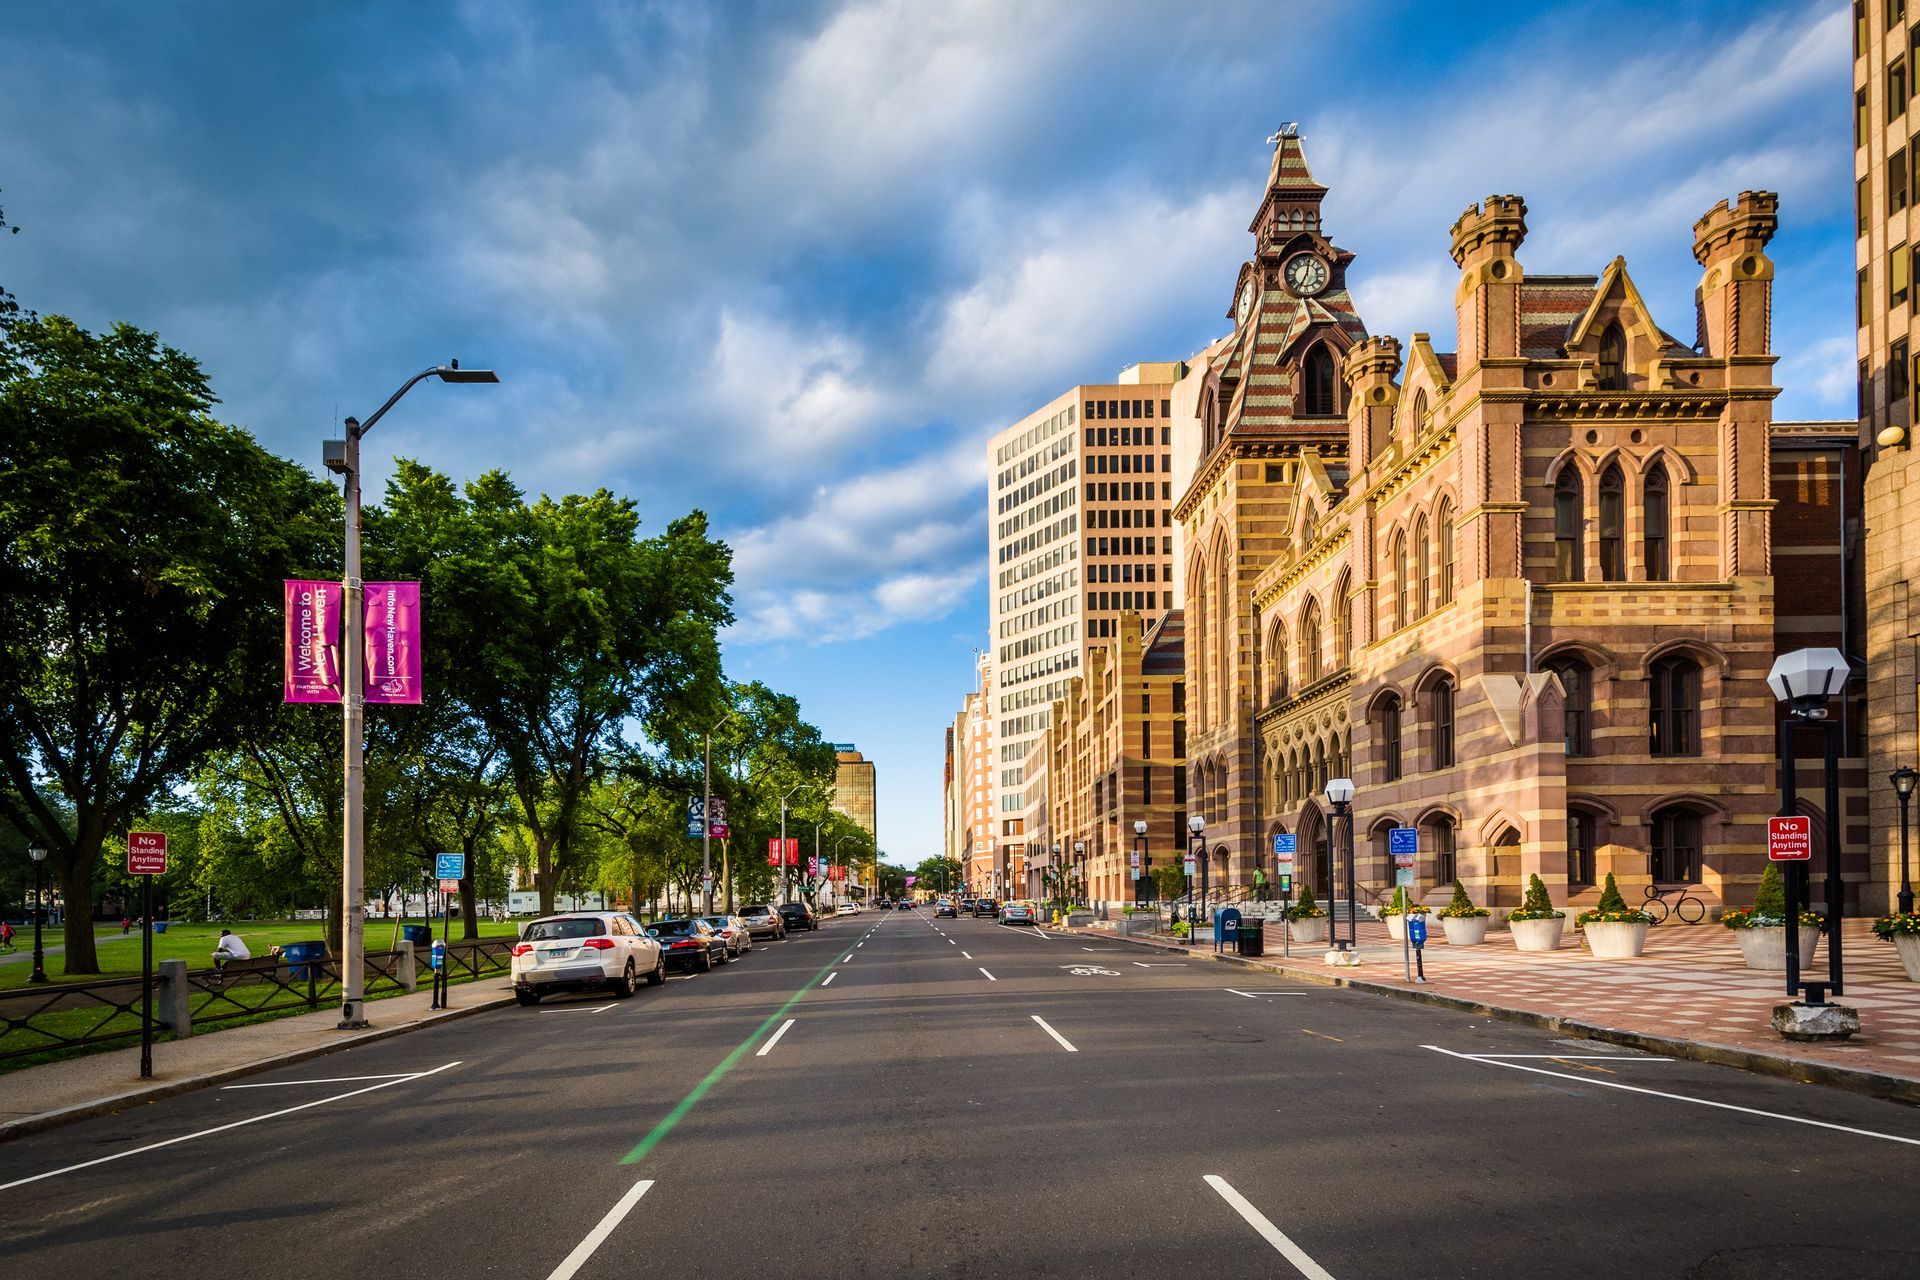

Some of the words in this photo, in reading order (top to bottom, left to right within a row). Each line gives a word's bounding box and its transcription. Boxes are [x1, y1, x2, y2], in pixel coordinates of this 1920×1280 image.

[299, 592, 312, 606] to
[312, 589, 327, 637] Haven
[387, 590, 396, 675] InfoNewHaven.com
[298, 609, 312, 671] Welcome
[312, 639, 326, 674] New
[1780, 822, 1798, 830] No
[138, 837, 156, 845] No
[1771, 832, 1807, 840] Standing
[131, 847, 164, 855] Standing
[1772, 842, 1807, 850] Anytime
